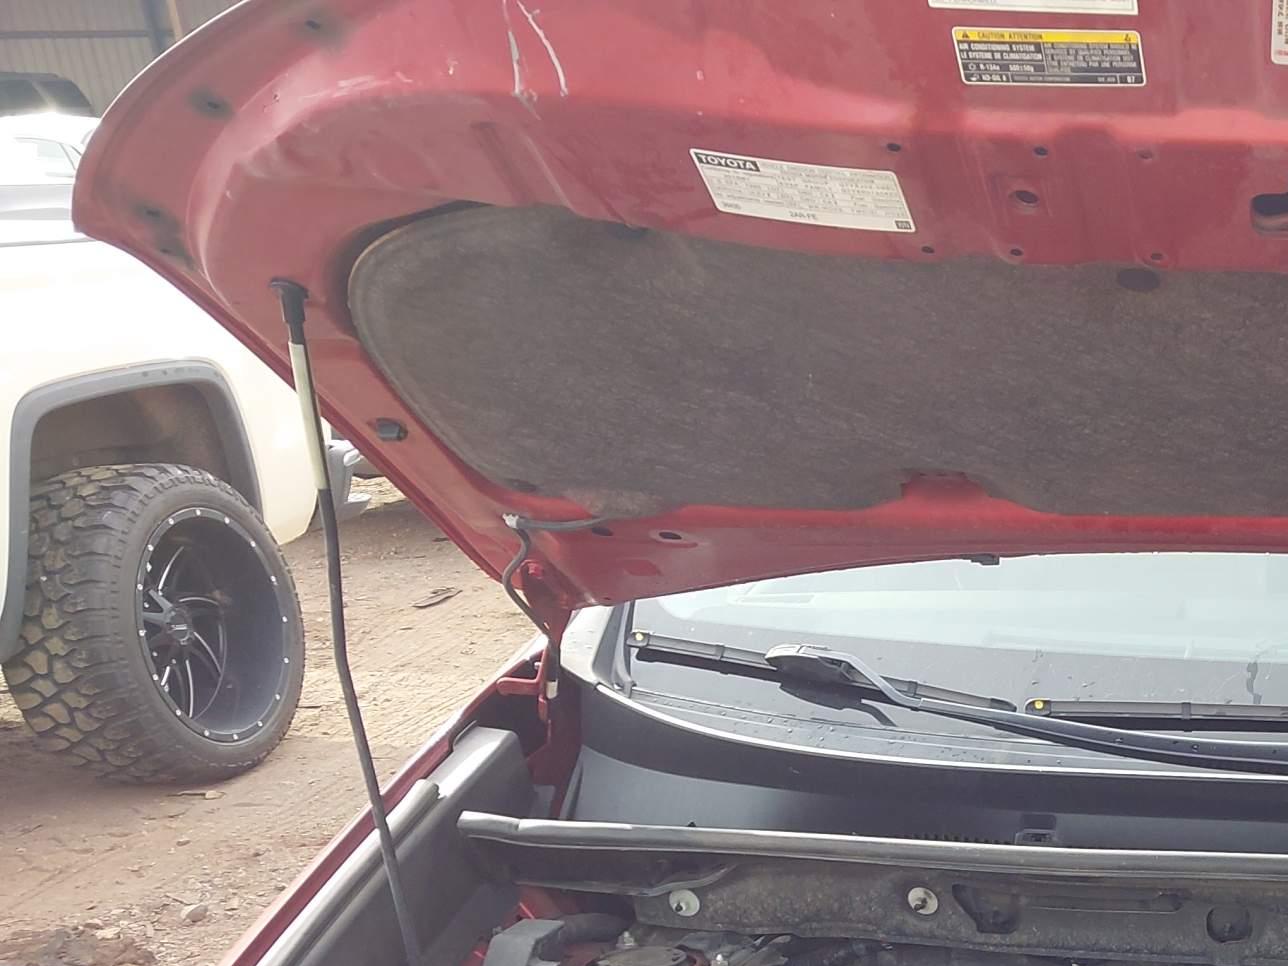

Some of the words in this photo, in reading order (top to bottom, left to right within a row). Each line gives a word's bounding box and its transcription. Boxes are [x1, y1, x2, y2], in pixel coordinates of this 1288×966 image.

[1009, 32, 1043, 40] ATTENTION
[1012, 44, 1035, 52] SYSTEM
[979, 63, 1000, 71] R-134a
[698, 154, 757, 171] TOYOTA
